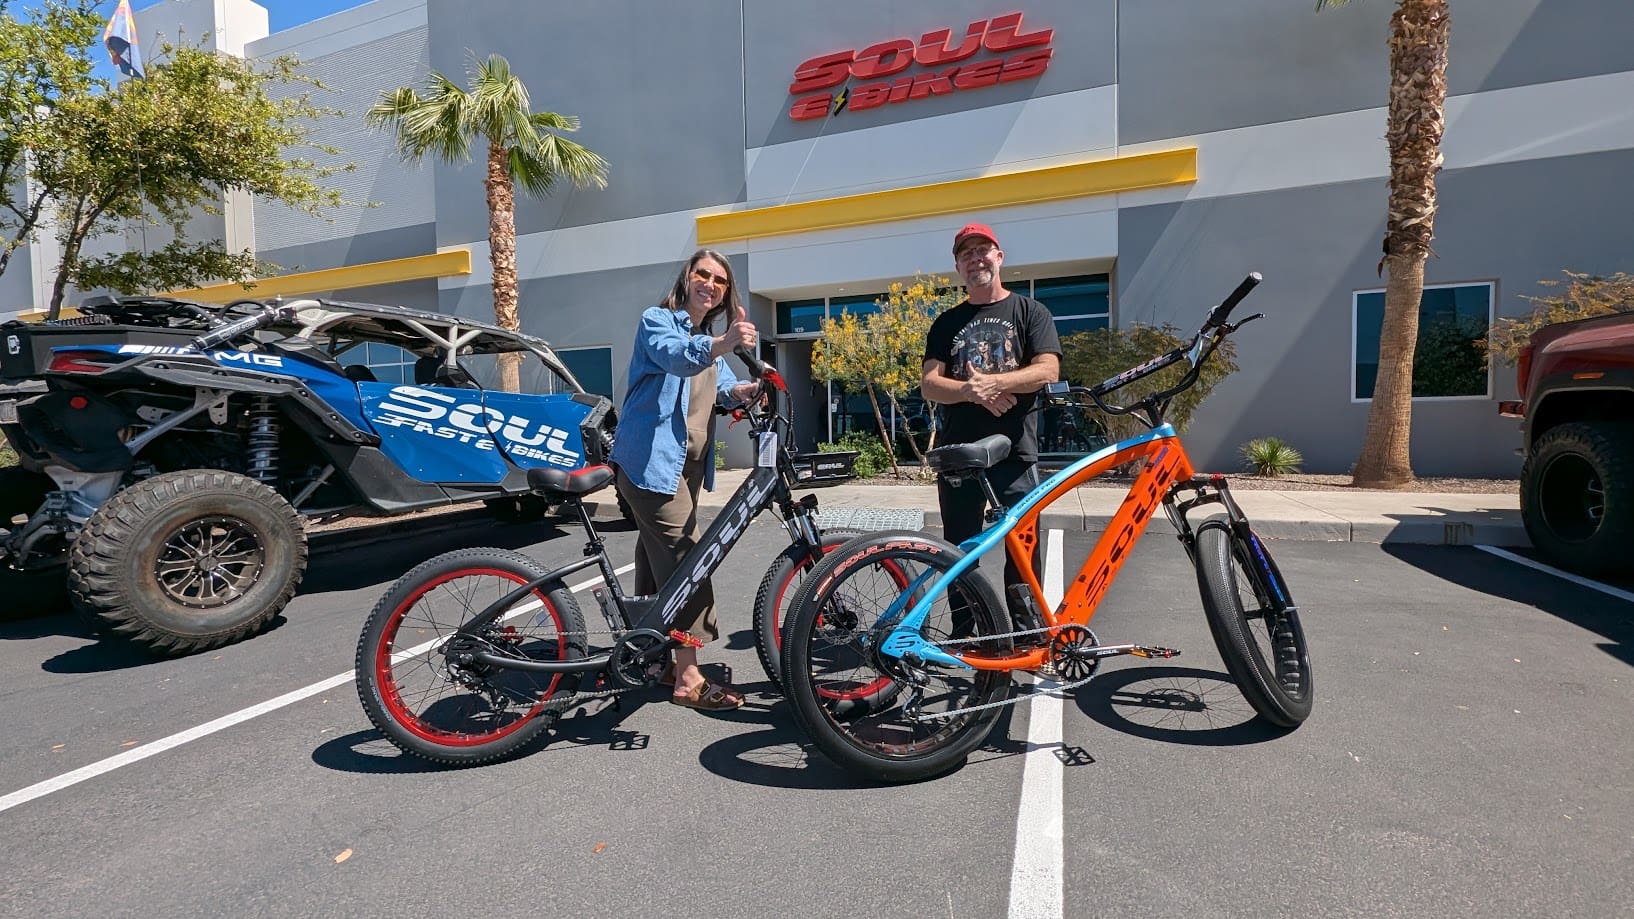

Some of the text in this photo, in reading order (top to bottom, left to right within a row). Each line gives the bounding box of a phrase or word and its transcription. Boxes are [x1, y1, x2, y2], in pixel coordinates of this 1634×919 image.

[789, 12, 1054, 95] SOUL
[789, 48, 1053, 121] E BIKES
[372, 413, 577, 468] FAST E BIKES
[379, 386, 580, 459] SOUL
[661, 477, 776, 625] SOUL
[833, 541, 942, 578] SOUL FAST
[1085, 455, 1180, 608] SOUL
